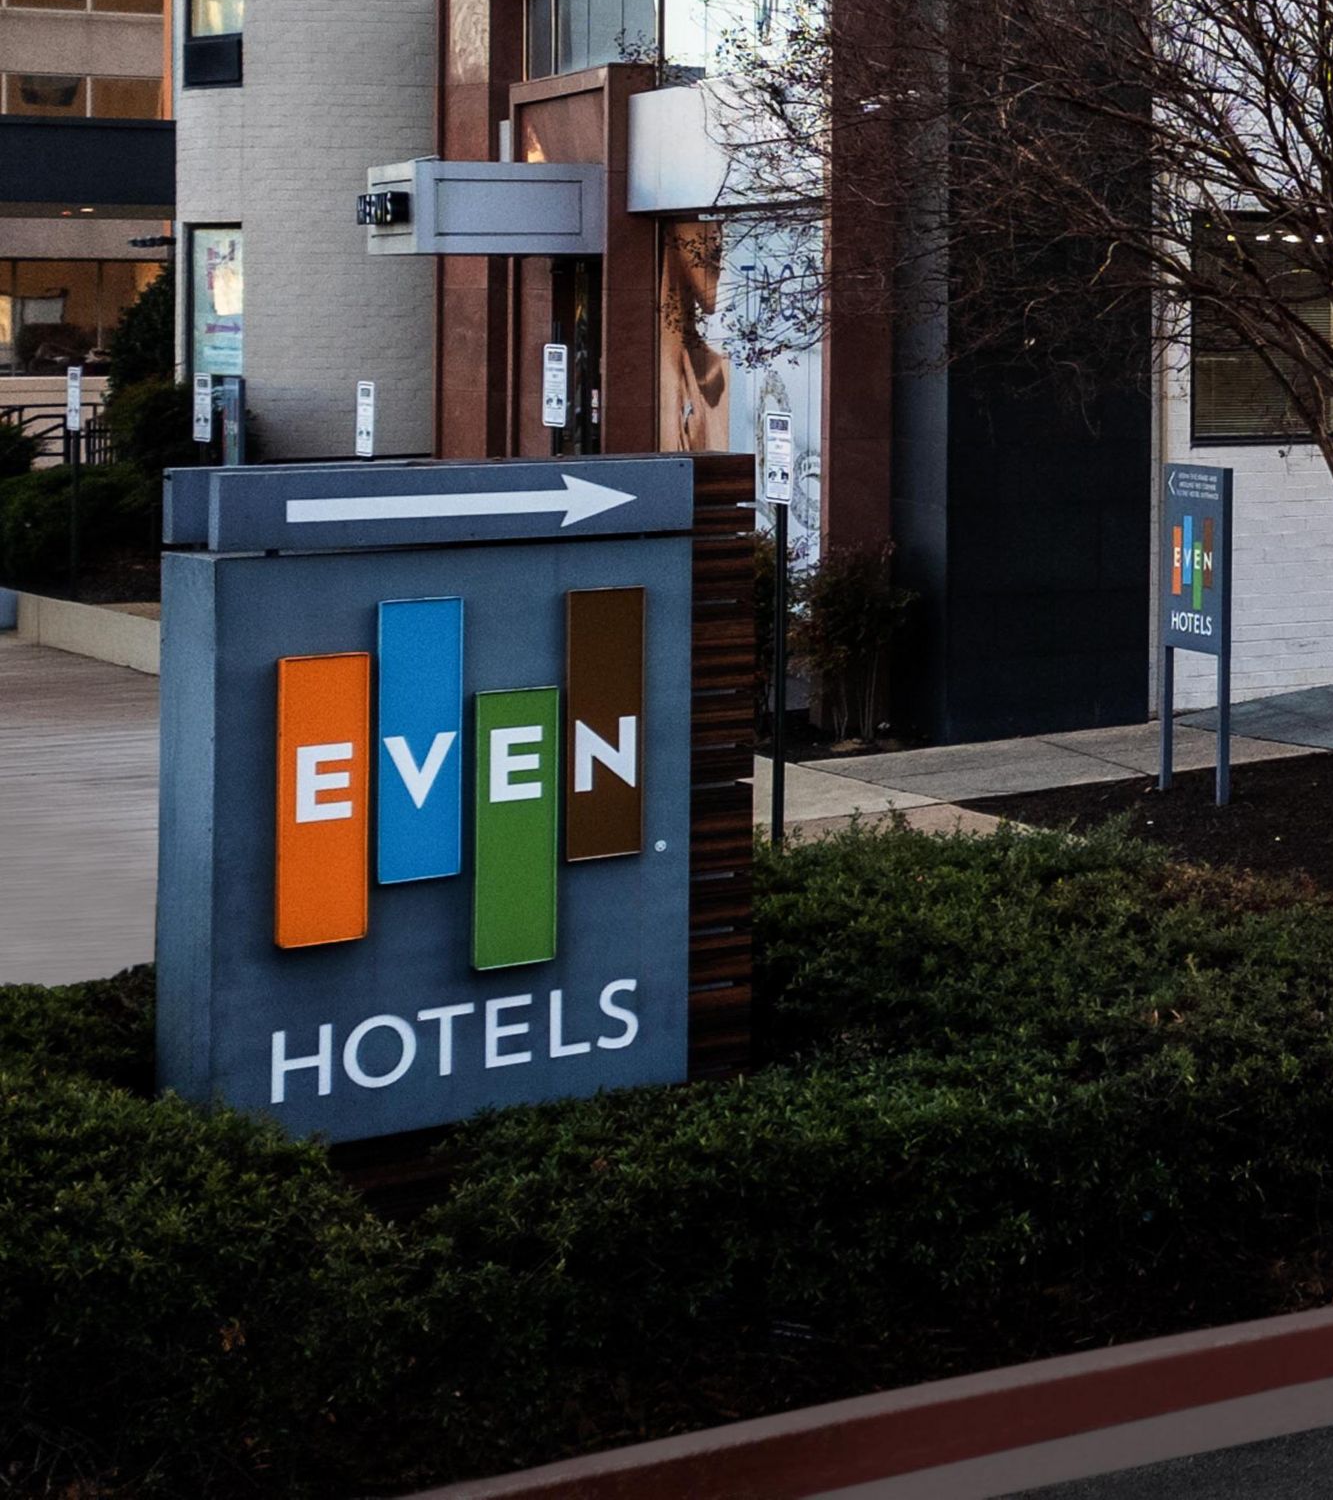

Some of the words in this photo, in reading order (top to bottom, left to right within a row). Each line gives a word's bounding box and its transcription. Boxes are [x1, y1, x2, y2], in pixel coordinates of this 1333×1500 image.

[1173, 546, 1213, 572] EVEN
[1170, 610, 1213, 636] HOTELS
[294, 715, 637, 824] EVEN
[270, 978, 639, 1103] HOTELS
